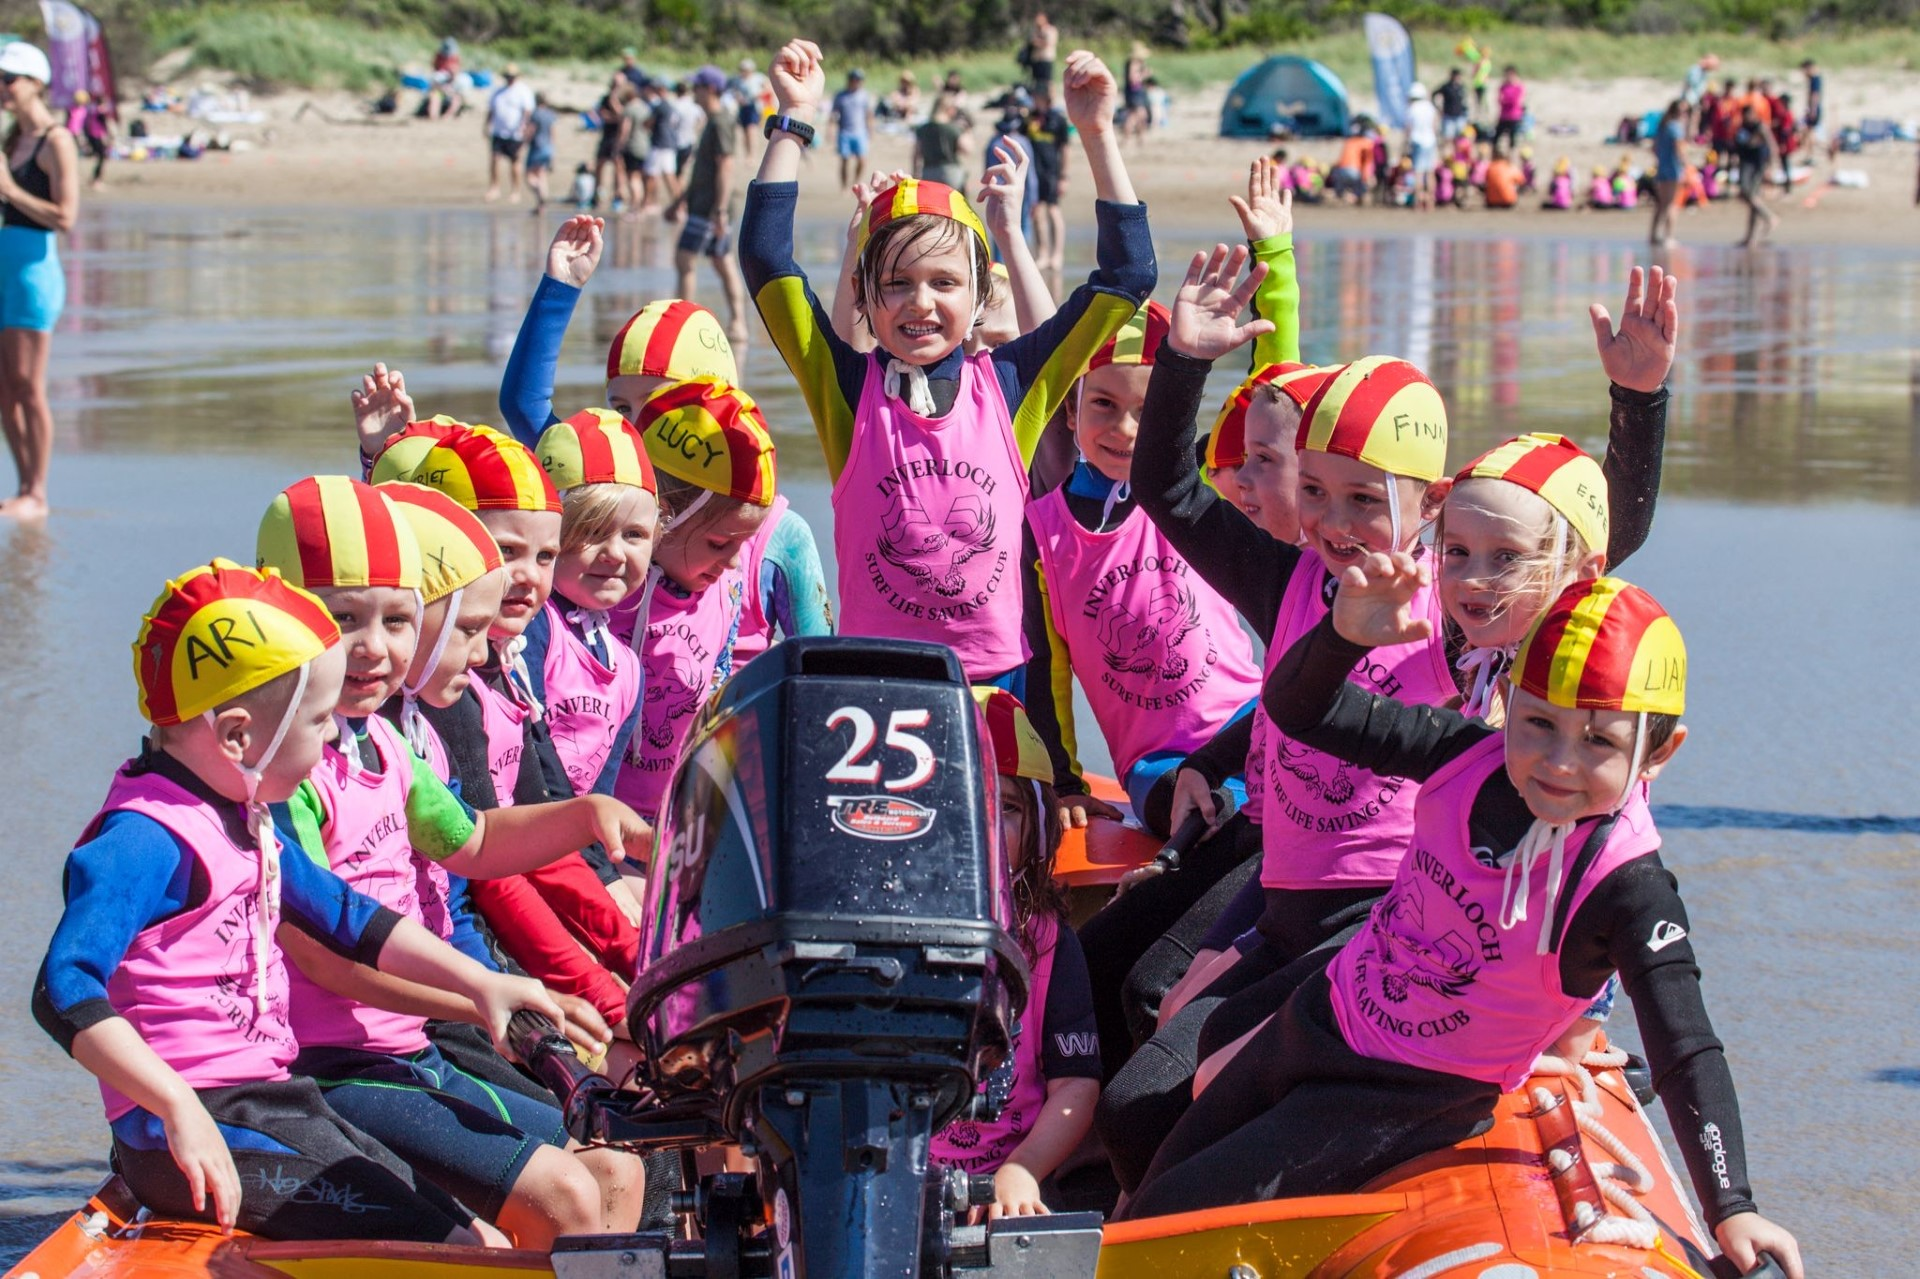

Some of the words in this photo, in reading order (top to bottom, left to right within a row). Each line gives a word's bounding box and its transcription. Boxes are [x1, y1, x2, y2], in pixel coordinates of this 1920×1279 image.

[657, 417, 724, 469] LUCY
[876, 459, 997, 498] INVERLOCH
[865, 552, 892, 596] SURF
[888, 592, 924, 620] LIFE
[928, 592, 989, 622] SAVING
[986, 550, 1008, 594] CLUB
[1083, 556, 1189, 621] INVERLOCH
[187, 611, 268, 680] ARI
[1101, 671, 1134, 704] SURF
[1165, 664, 1212, 708] SAVING
[637, 754, 677, 772] SAVIN
[825, 706, 936, 792] 25
[1270, 759, 1287, 804] SURF
[1284, 801, 1314, 831] LIFE
[1316, 800, 1380, 833] SAVING
[1378, 775, 1405, 804] CLU
[345, 813, 404, 872] INVERL
[1356, 987, 1413, 1037] SAVING
[1417, 1009, 1470, 1037] CLUB
[1711, 1129, 1730, 1189] prologue
